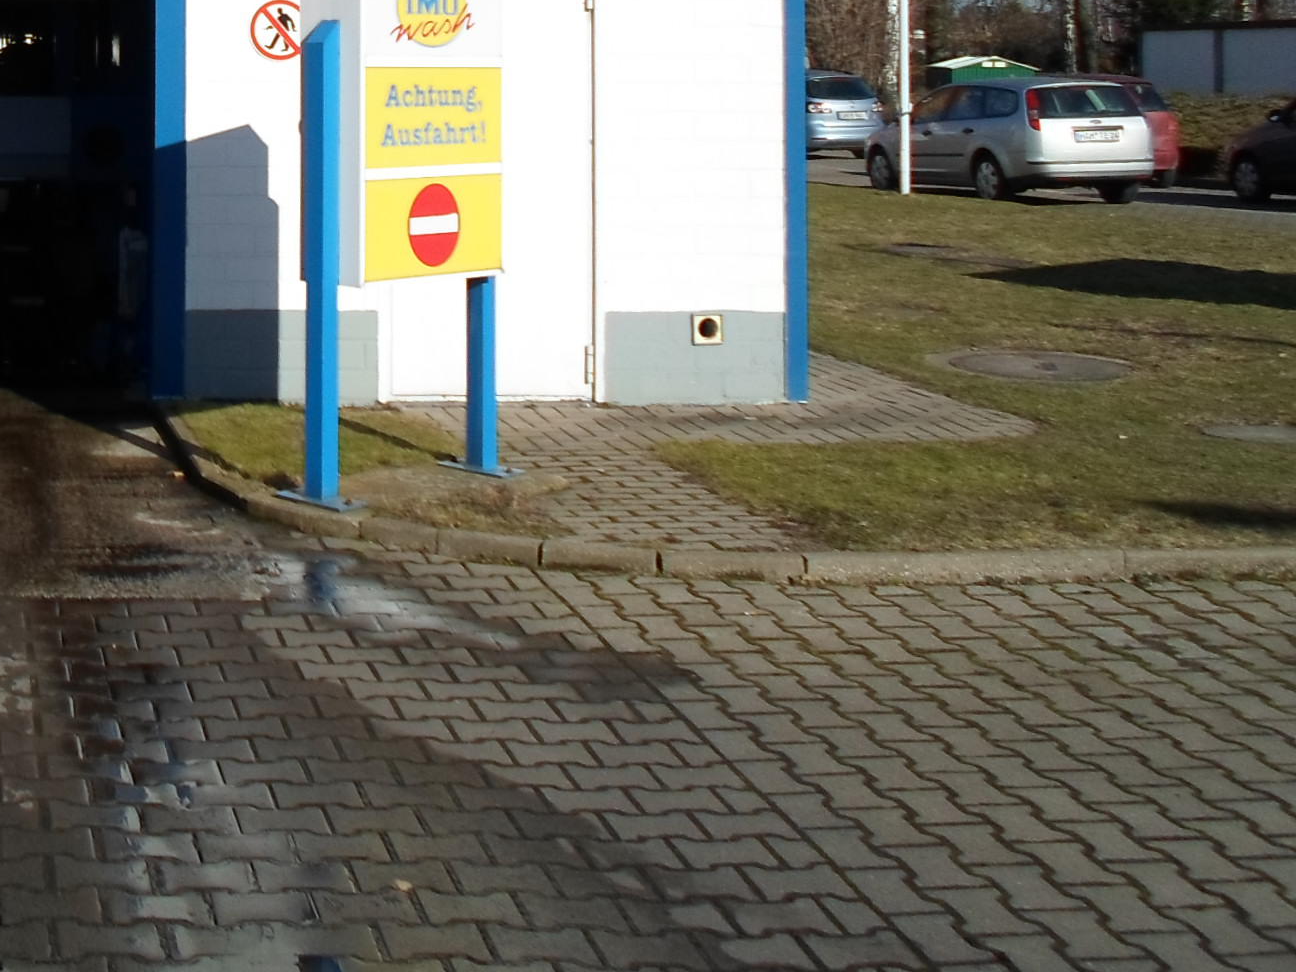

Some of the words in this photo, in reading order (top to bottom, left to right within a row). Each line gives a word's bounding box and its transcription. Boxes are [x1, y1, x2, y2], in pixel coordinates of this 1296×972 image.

[390, 3, 475, 42] wash
[385, 84, 482, 113] Achtung,
[381, 121, 486, 147] Ausfahrt!
